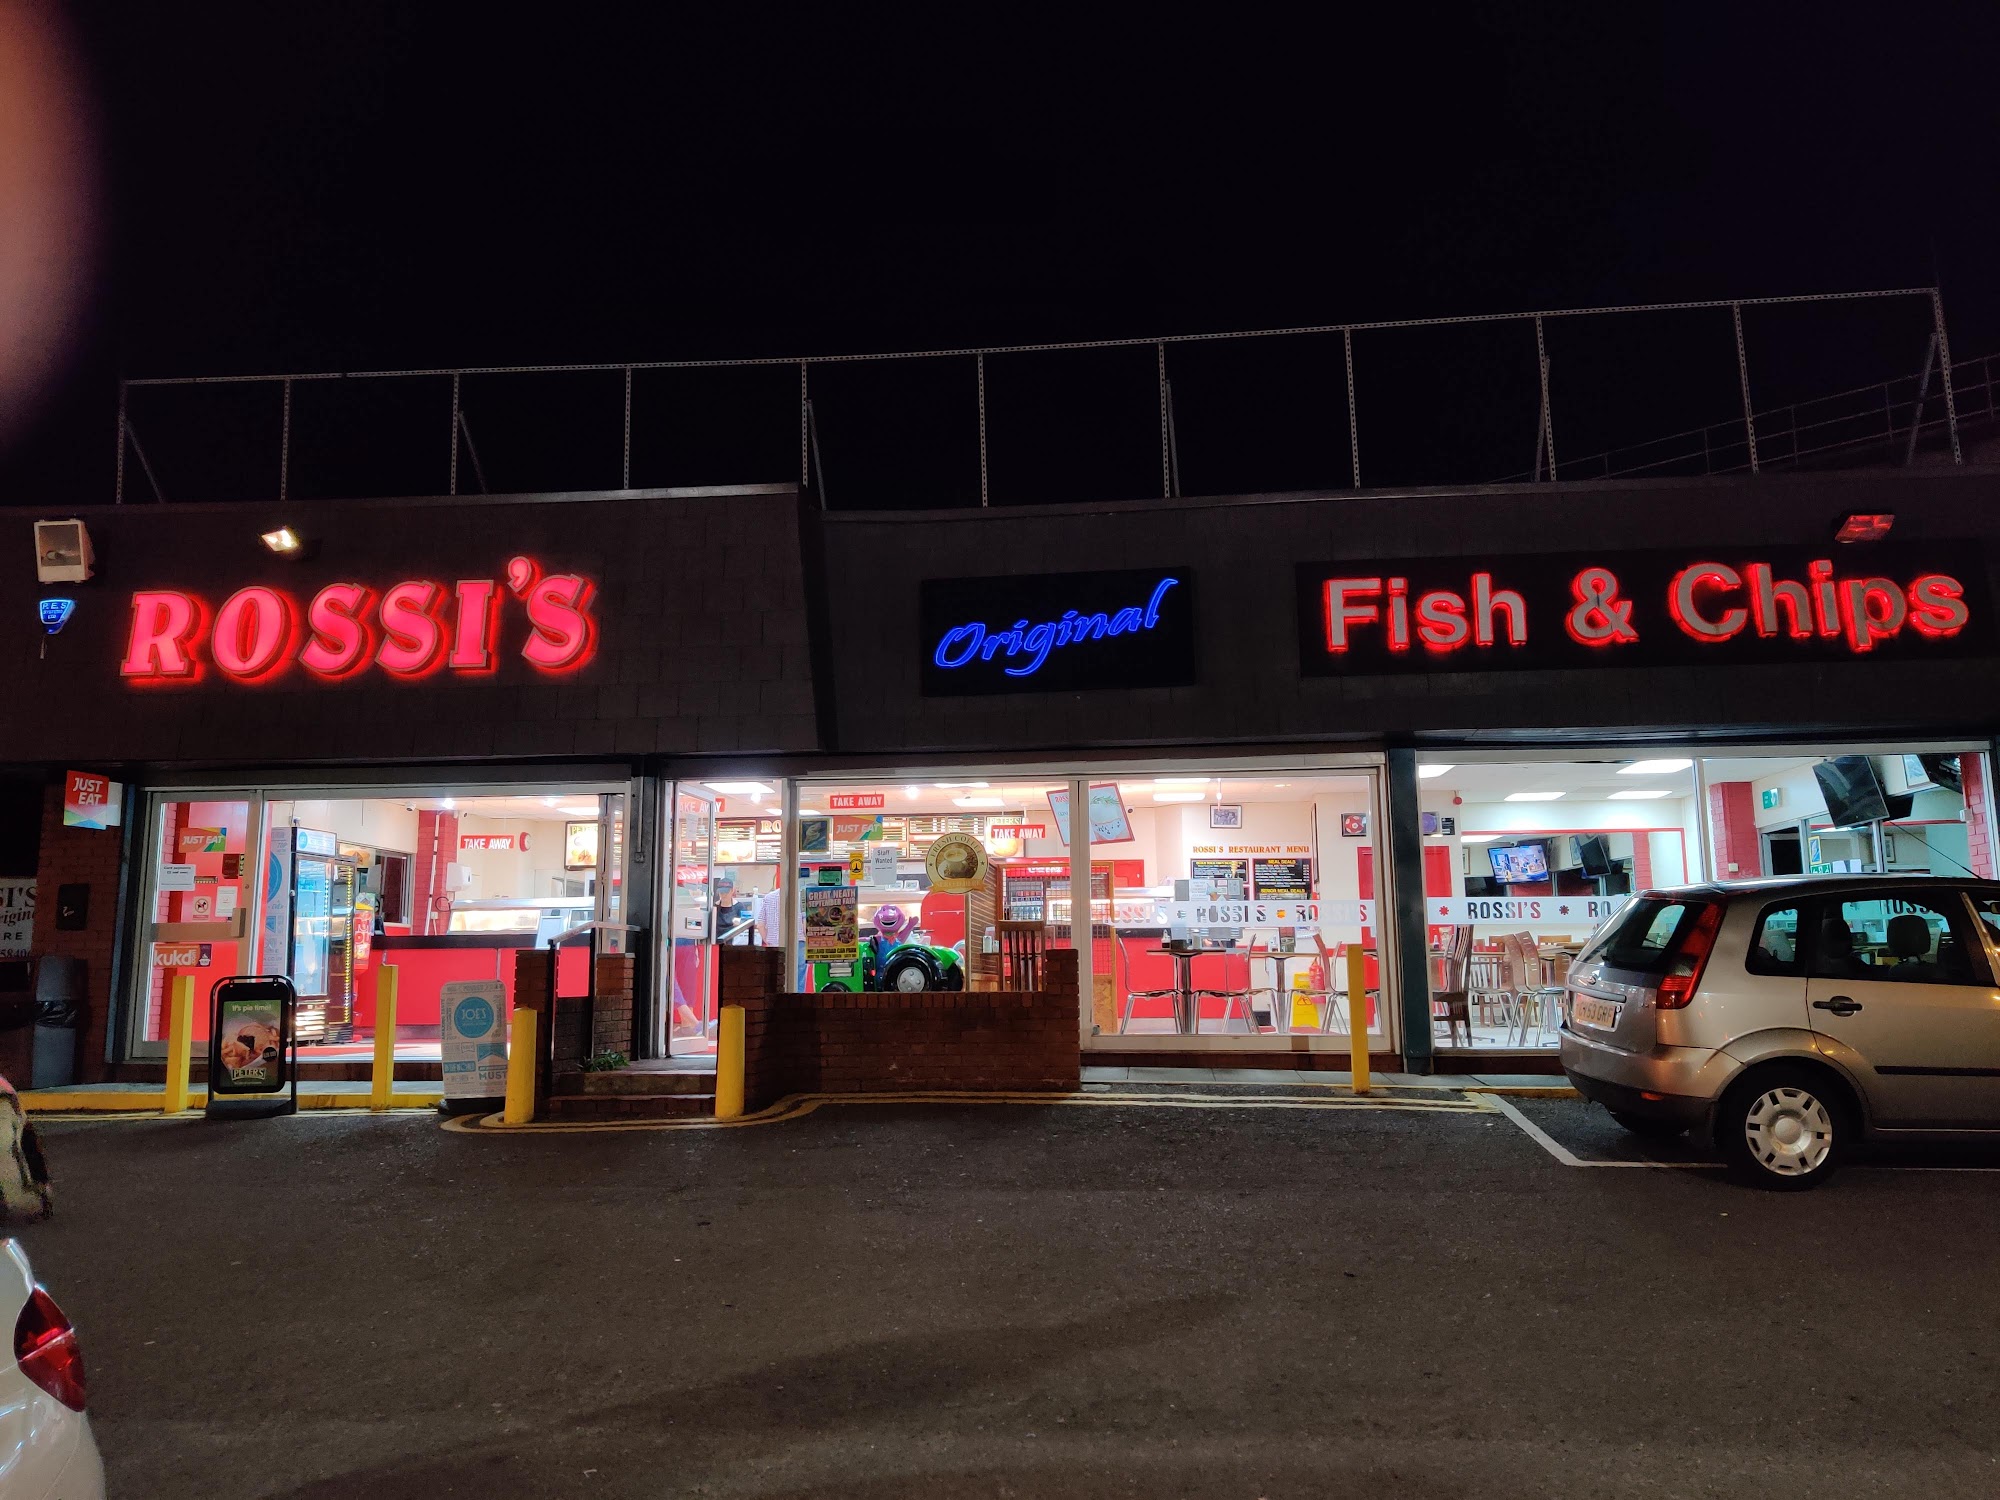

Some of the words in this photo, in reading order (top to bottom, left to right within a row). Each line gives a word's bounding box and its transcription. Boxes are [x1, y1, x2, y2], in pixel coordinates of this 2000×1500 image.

[1324, 572, 1526, 653] Fish
[1566, 567, 1638, 646] &
[1668, 559, 1968, 653] Chips
[120, 556, 591, 677] ROSSI'S
[935, 577, 1178, 674] Original
[73, 777, 103, 792] JUST
[78, 792, 102, 806] EAT
[833, 797, 854, 807] TAKE
[858, 796, 882, 806] AWAY
[679, 802, 695, 813] AKE
[836, 824, 859, 834] JUST
[861, 824, 880, 832] EAT
[993, 828, 1015, 839] TAKE
[1019, 828, 1043, 838] AWAY
[182, 836, 205, 845] JUST
[206, 836, 223, 844] EAT
[464, 838, 485, 849] TAKE
[488, 838, 511, 849] AWAY
[930, 836, 952, 857] FRESH
[954, 835, 981, 854] COFFEE
[1286, 845, 1310, 853] MENU
[809, 890, 831, 901] GREAT
[833, 888, 856, 899] NEATH
[808, 899, 841, 908] SEPTEMBER
[842, 897, 856, 905] FAIR
[1197, 905, 1266, 923] ROSSIS
[1467, 901, 1541, 920] ROSSI'S
[153, 949, 192, 967] kukd
[234, 1069, 264, 1079] PETER'S
